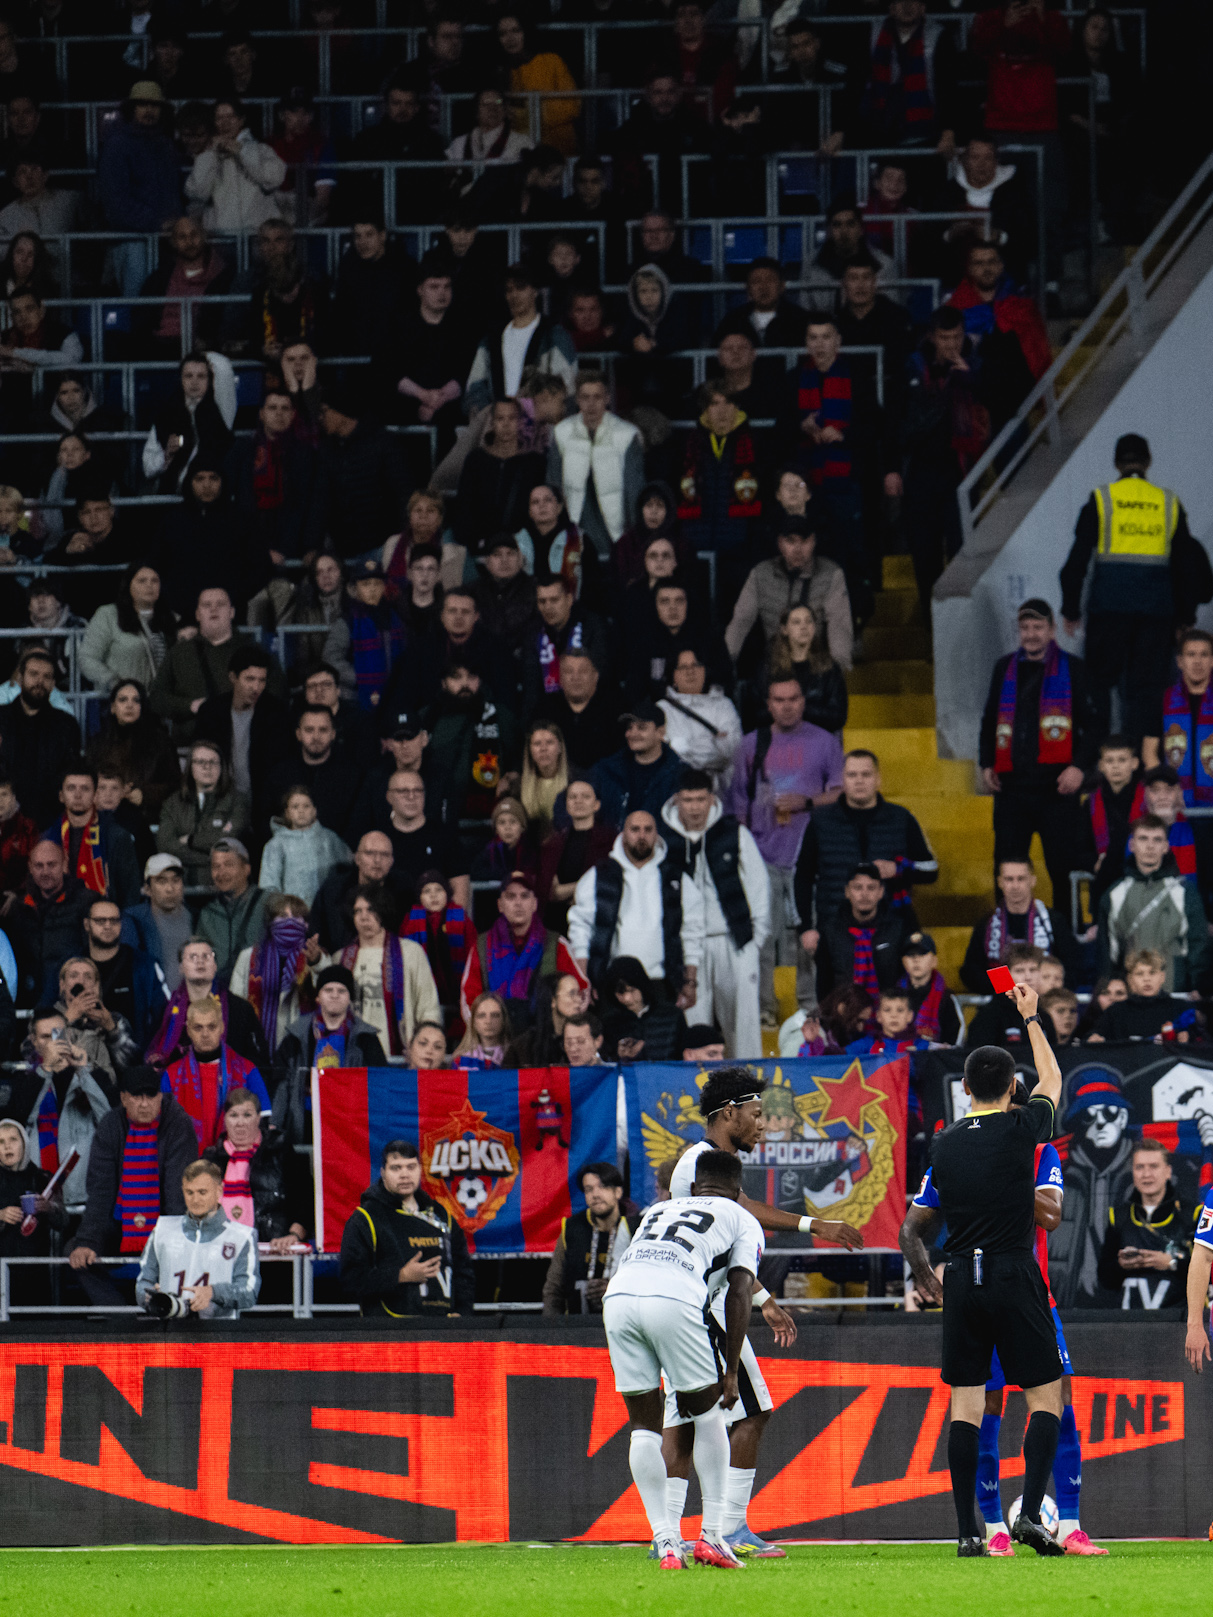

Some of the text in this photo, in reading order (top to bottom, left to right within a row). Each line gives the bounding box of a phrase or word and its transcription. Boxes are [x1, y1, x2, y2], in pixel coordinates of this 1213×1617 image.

[429, 1139, 514, 1176] ЦСКА
[764, 1140, 838, 1165] РОССИИ
[635, 1207, 715, 1254] 12
[635, 1252, 694, 1272] ОРГСИНТЕЗ
[636, 1247, 678, 1259] КАЗАНЬ
[1121, 1277, 1171, 1310] TV
